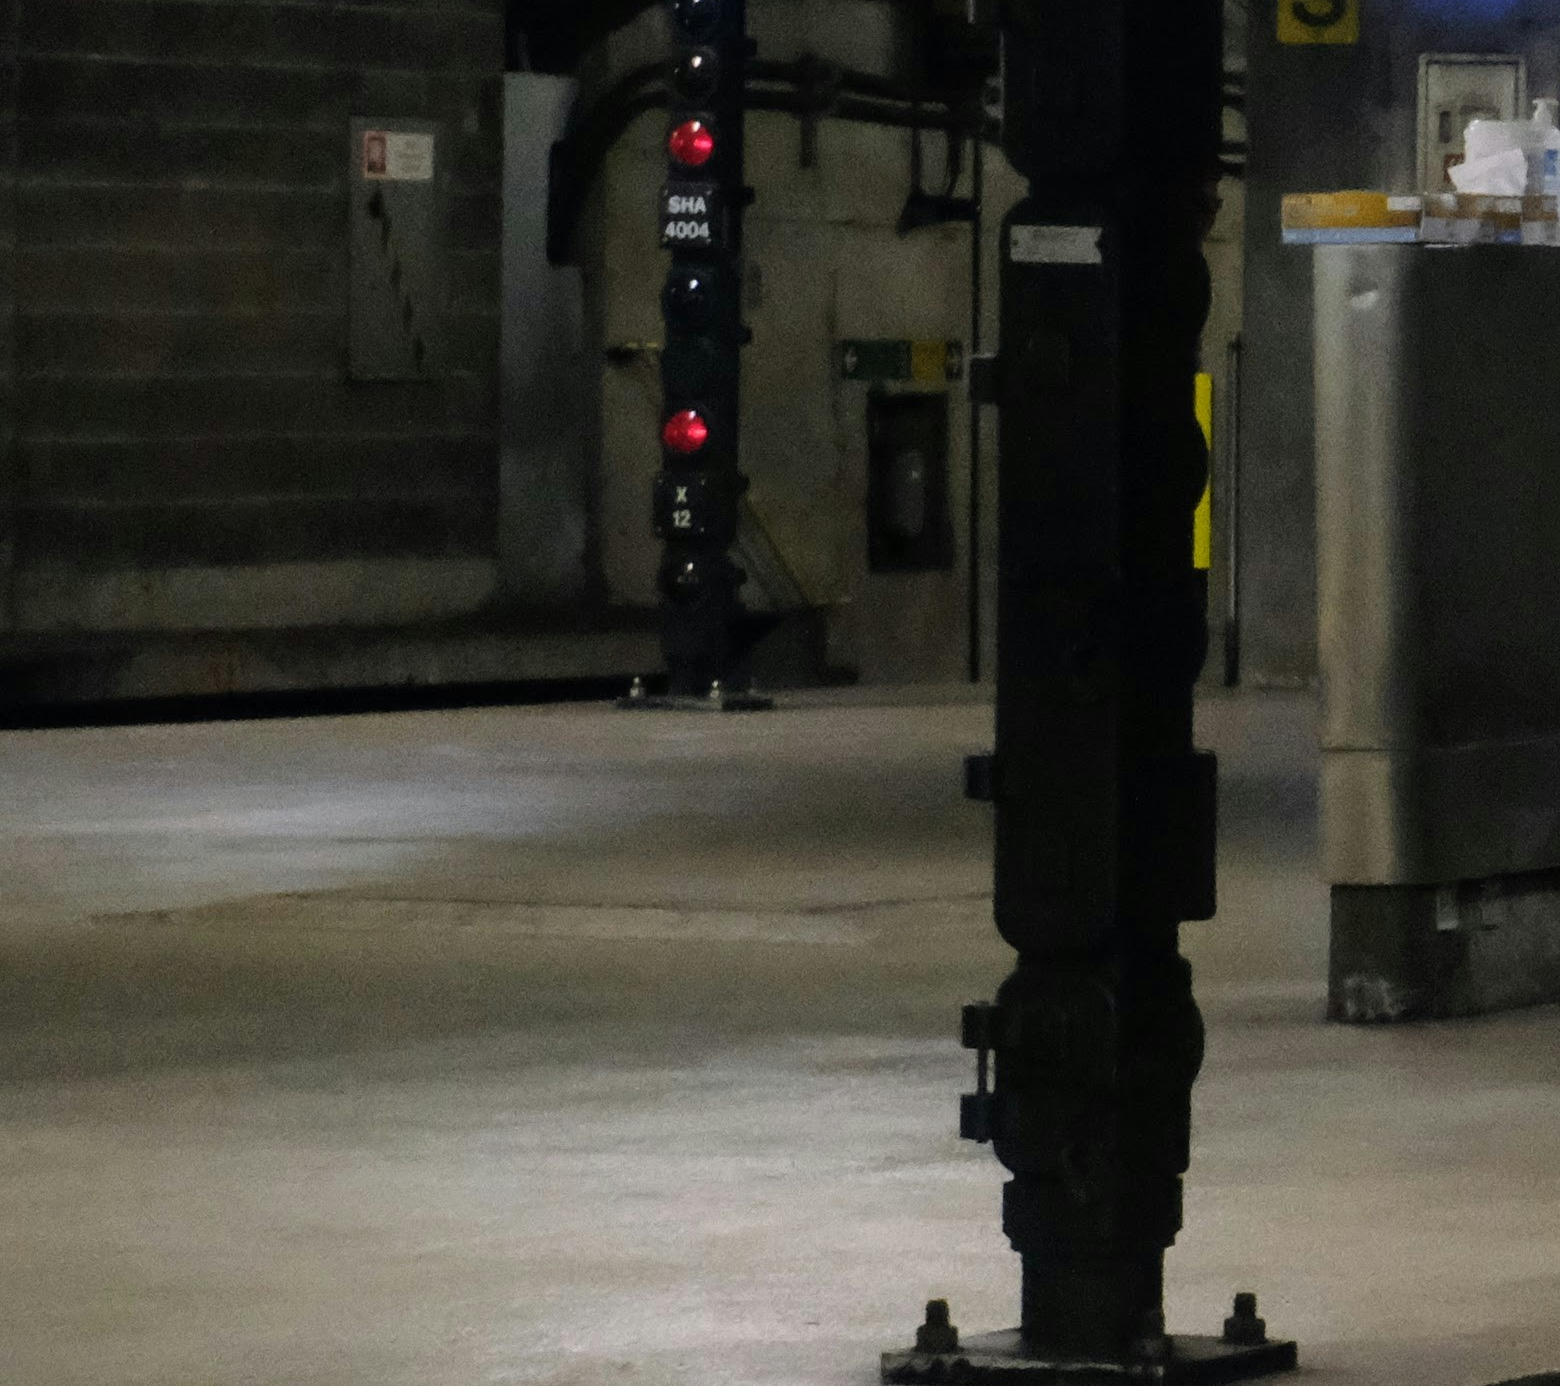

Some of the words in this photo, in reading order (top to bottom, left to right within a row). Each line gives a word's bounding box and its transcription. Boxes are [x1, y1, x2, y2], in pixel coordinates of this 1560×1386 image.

[668, 195, 707, 214] SHA
[665, 221, 709, 240] 4004
[676, 485, 688, 504] X
[672, 509, 692, 528] 12
